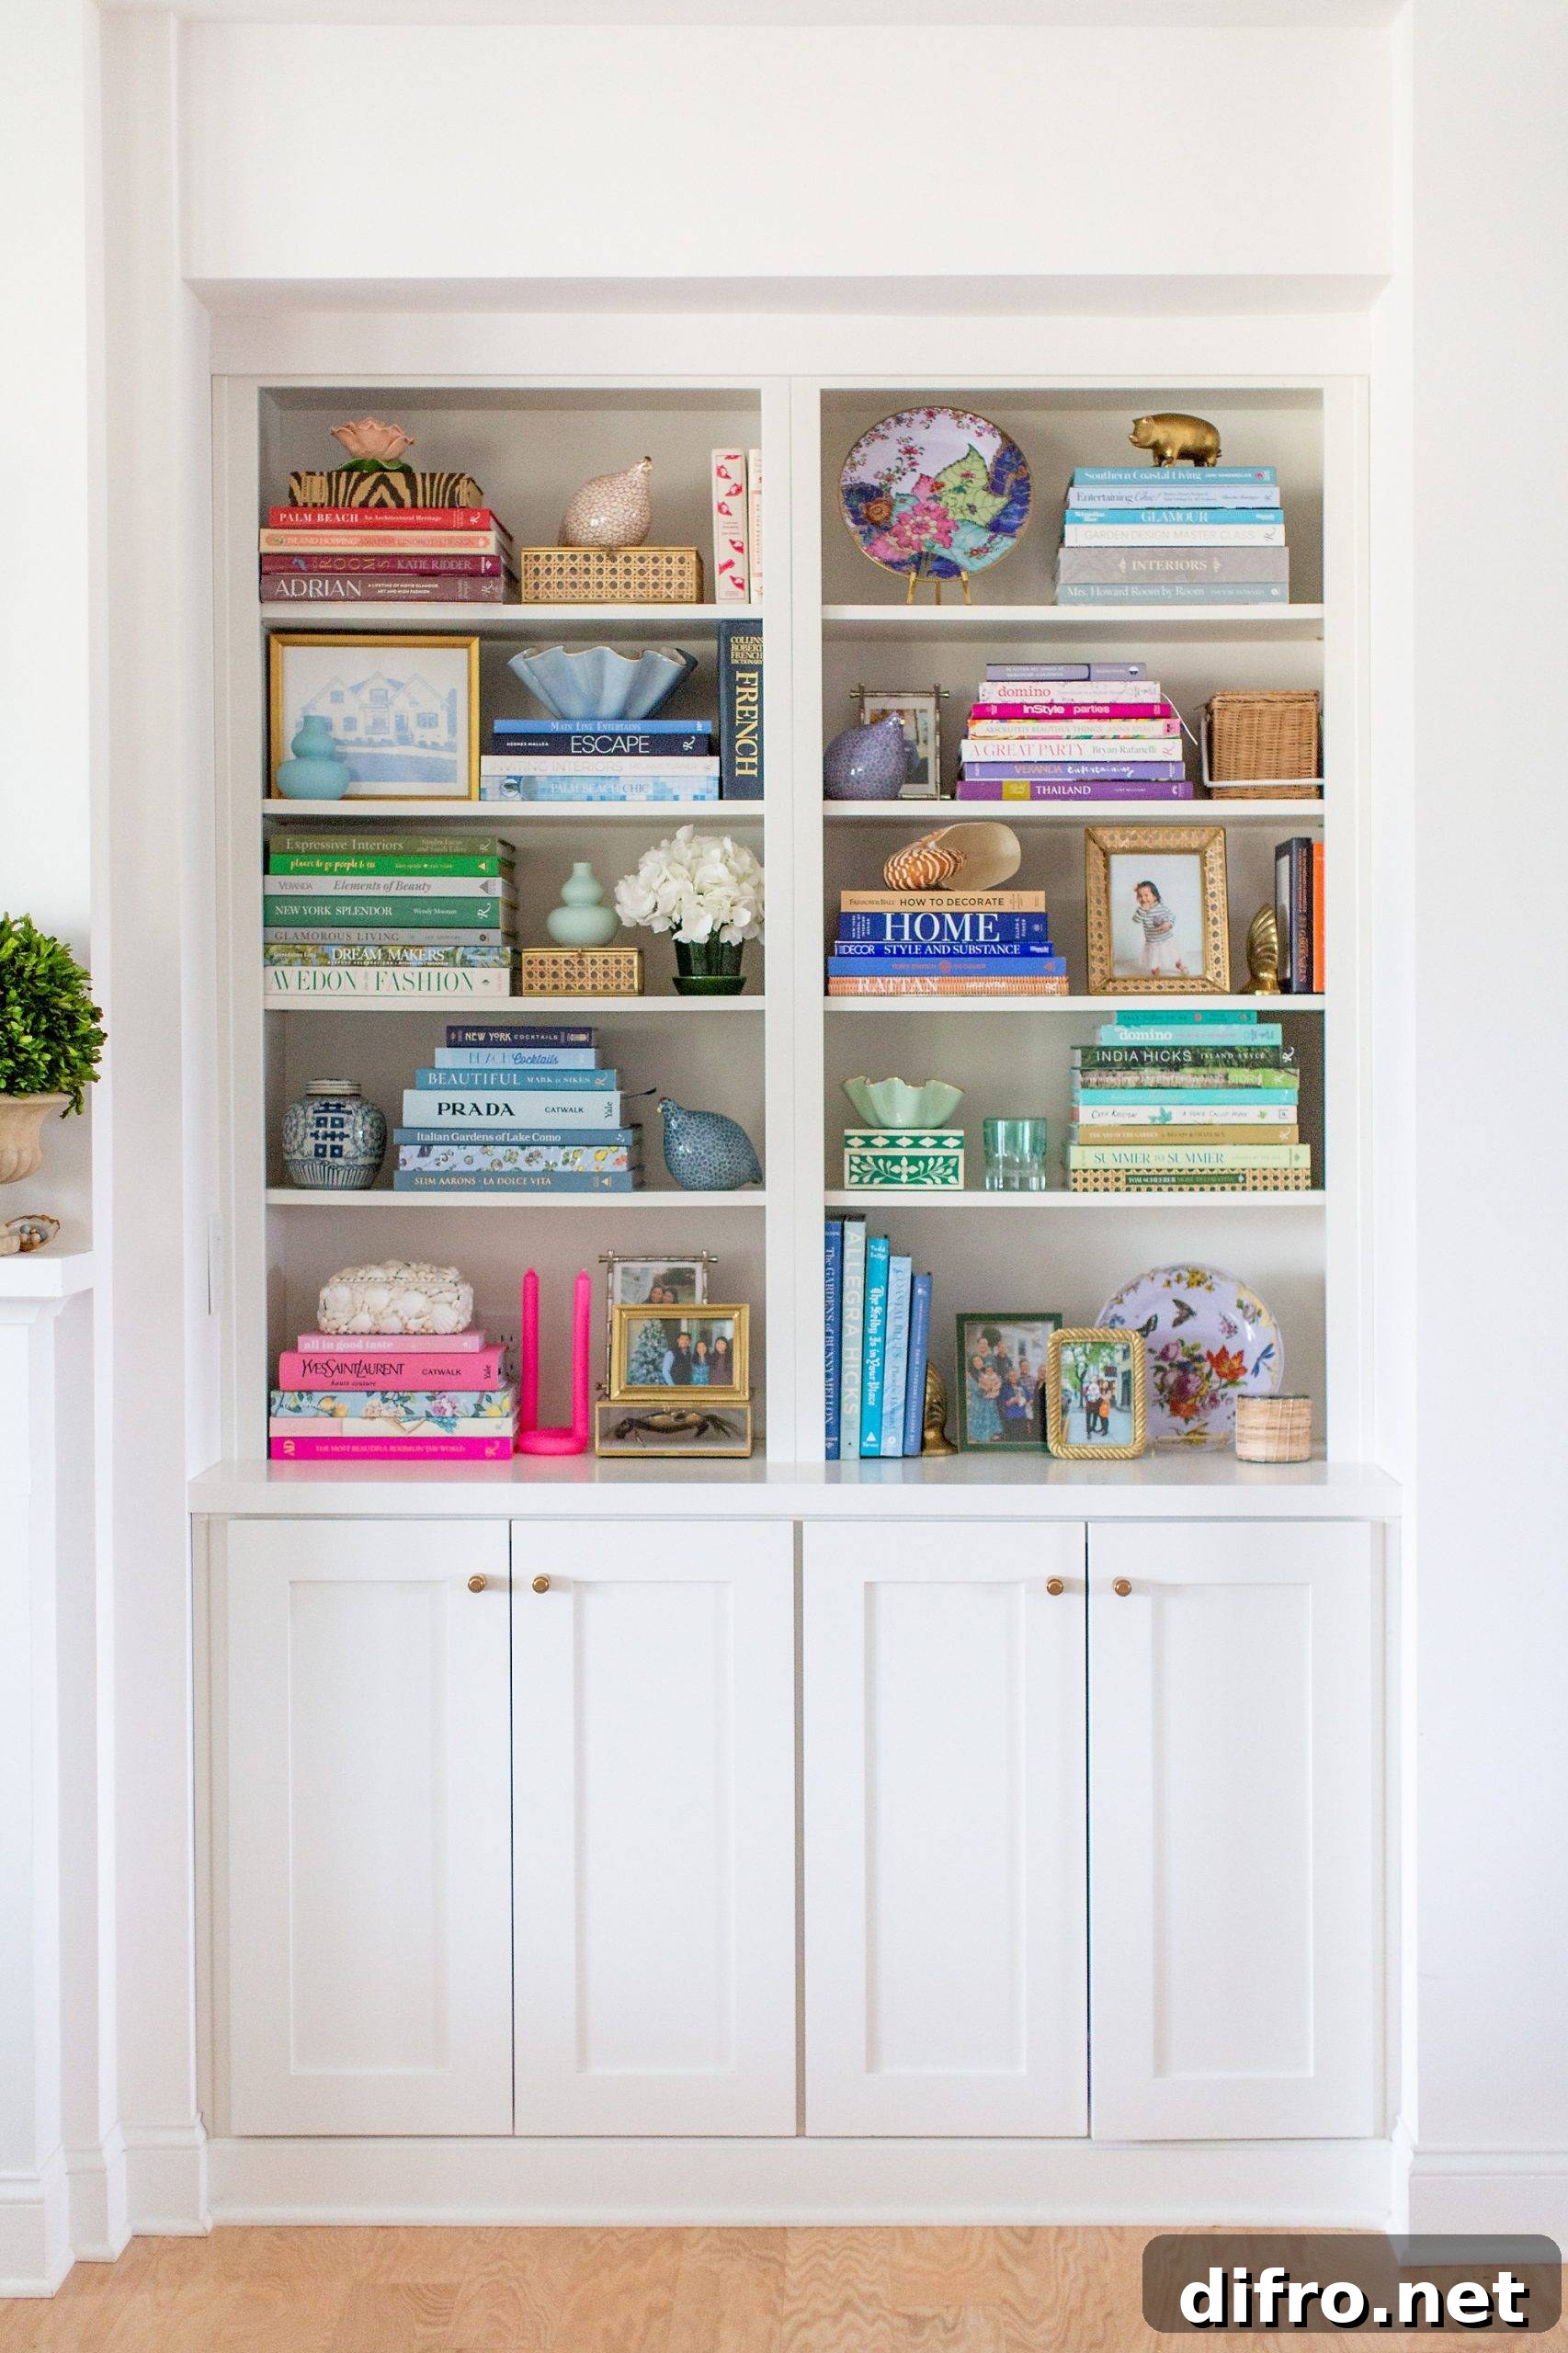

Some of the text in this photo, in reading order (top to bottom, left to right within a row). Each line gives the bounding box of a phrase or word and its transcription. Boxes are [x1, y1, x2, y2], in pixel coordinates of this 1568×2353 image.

[1085, 471, 1131, 479] Southern
[1132, 471, 1170, 479] Coastal
[1172, 471, 1201, 481] Living
[1076, 492, 1133, 504] Entertaining
[279, 513, 312, 522] PALM
[316, 513, 358, 522] BEACH
[1141, 511, 1209, 522] GLAMOUR
[1085, 529, 1255, 540] GARDEN DESIGN MASTER CLASS
[319, 557, 472, 570] ROOMS KATIE RIDDER
[1132, 559, 1208, 570] INTERIORS
[275, 578, 361, 597] ADRIAN
[1091, 585, 1129, 597] Howard
[1131, 586, 1160, 597] Room
[1161, 586, 1172, 599] by
[1176, 586, 1205, 597] Room
[998, 686, 1051, 697] domino
[1023, 704, 1110, 715] InStyle parties
[735, 671, 758, 777] FRENCH
[571, 735, 650, 753] ESCAPE
[983, 744, 1032, 756] GREAT
[1039, 744, 1086, 756] PARTY
[1092, 745, 1118, 756] Bryan
[492, 760, 623, 773] INVITING INTERIORS
[622, 783, 649, 793] CHIC
[1035, 785, 1092, 795] THAILAND
[286, 837, 403, 853] Expressive Interiors
[333, 881, 382, 891] Elements
[383, 881, 395, 892] of
[395, 881, 432, 893] Beauty
[900, 898, 926, 906] HOW
[929, 898, 944, 906] TO
[947, 897, 1005, 906] DECORATE
[276, 905, 433, 915] NEW YORK SPLENDOR Wendy
[882, 912, 1000, 943] HOME
[274, 931, 399, 941] GLAMOROUS LIVING
[332, 948, 382, 961] DREAM
[387, 949, 445, 961] MAKERS
[843, 944, 875, 955] DECOR
[884, 944, 923, 955] STYLE
[924, 944, 950, 955] AND
[952, 944, 1021, 955] SUBSTANCE
[375, 971, 473, 992] FASHION
[857, 977, 938, 993] RATTAN
[464, 1031, 485, 1042] NEW
[488, 1031, 512, 1042] YORK
[1119, 1029, 1173, 1040] domino
[511, 1052, 560, 1064] Cocktails
[1096, 1050, 1139, 1062] INDIA
[1143, 1050, 1192, 1062] HICKS
[428, 1073, 521, 1086] BEAUTIFUL
[437, 1101, 613, 1119] PRADA CATWALK Yale
[416, 1131, 562, 1142] Italian Gardens of Lake Como
[1094, 1153, 1151, 1164] SUMMER
[1167, 1153, 1224, 1164] SUMMER
[414, 1176, 551, 1186] SLIM AARONS LA DOLCE VITA
[843, 1230, 861, 1338] ALLEGRA
[824, 1267, 835, 1322] GARDENS
[868, 1285, 885, 1305] The
[867, 1305, 883, 1334] Selby
[303, 1339, 393, 1353] all in good taste
[824, 1336, 835, 1374] BUNNY
[869, 1348, 880, 1358] in
[483, 1364, 492, 1380] Yale
[865, 1358, 881, 1381] Your
[842, 1347, 859, 1415] HICKS
[867, 1381, 880, 1405] Place
[824, 1377, 835, 1425] MELLON
